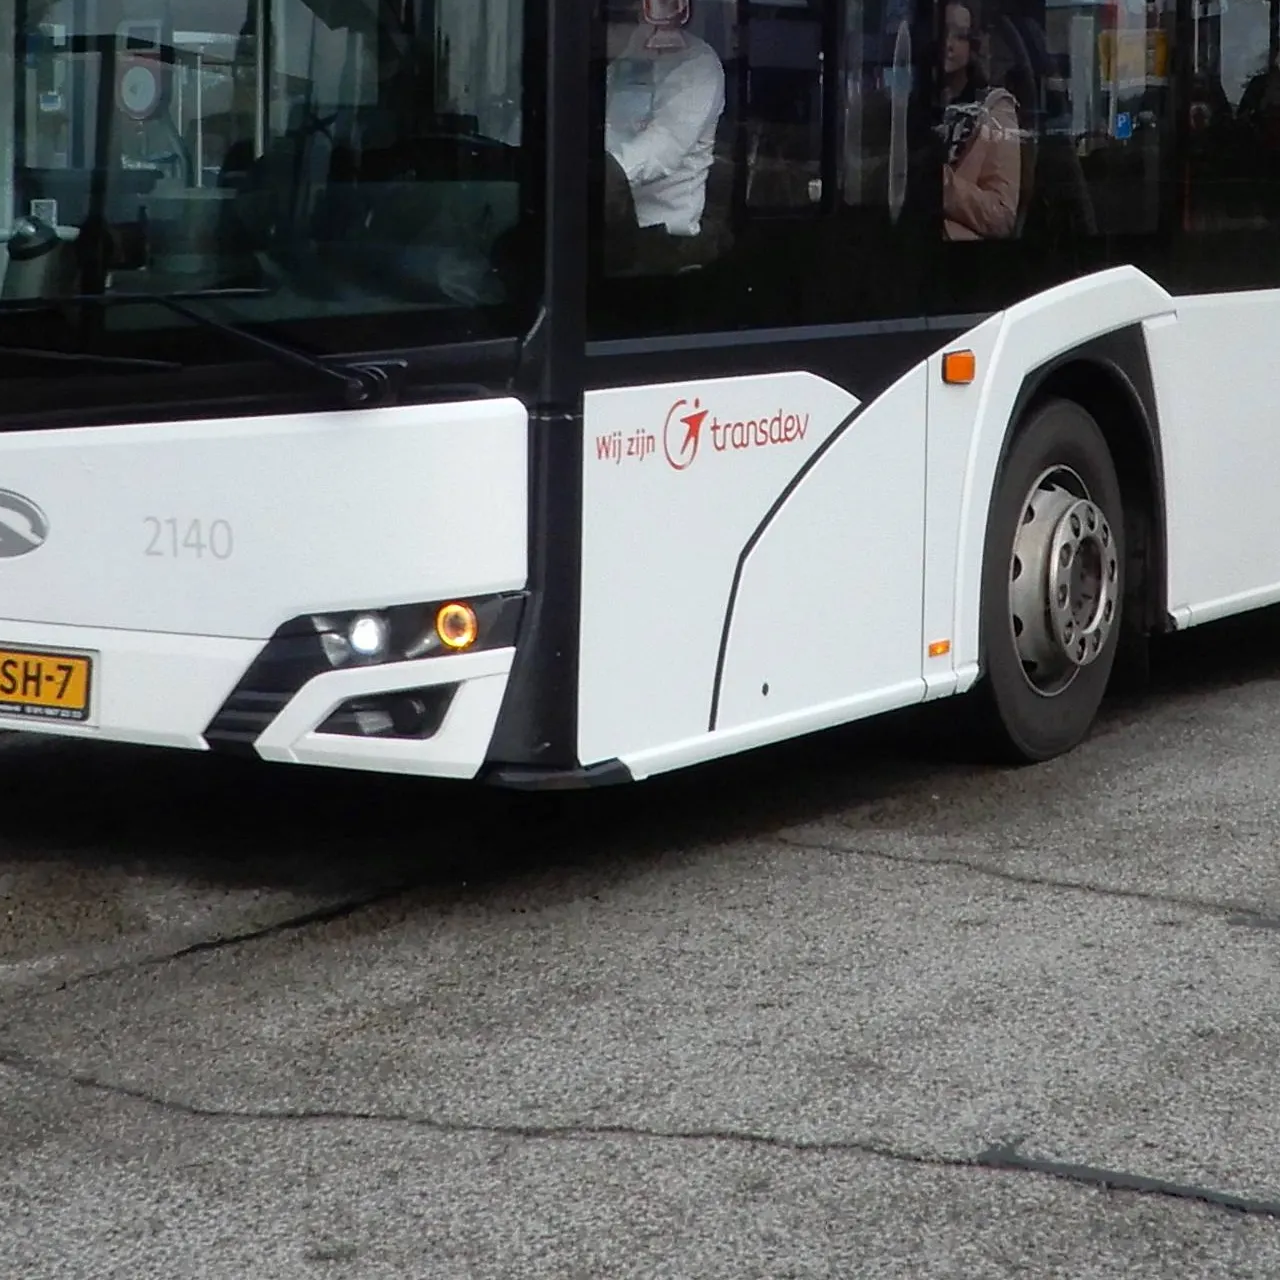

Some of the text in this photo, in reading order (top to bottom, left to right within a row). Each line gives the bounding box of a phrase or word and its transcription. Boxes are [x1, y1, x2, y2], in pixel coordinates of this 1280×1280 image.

[596, 408, 810, 465] Wij zijn transdev
[143, 516, 234, 559] 2140
